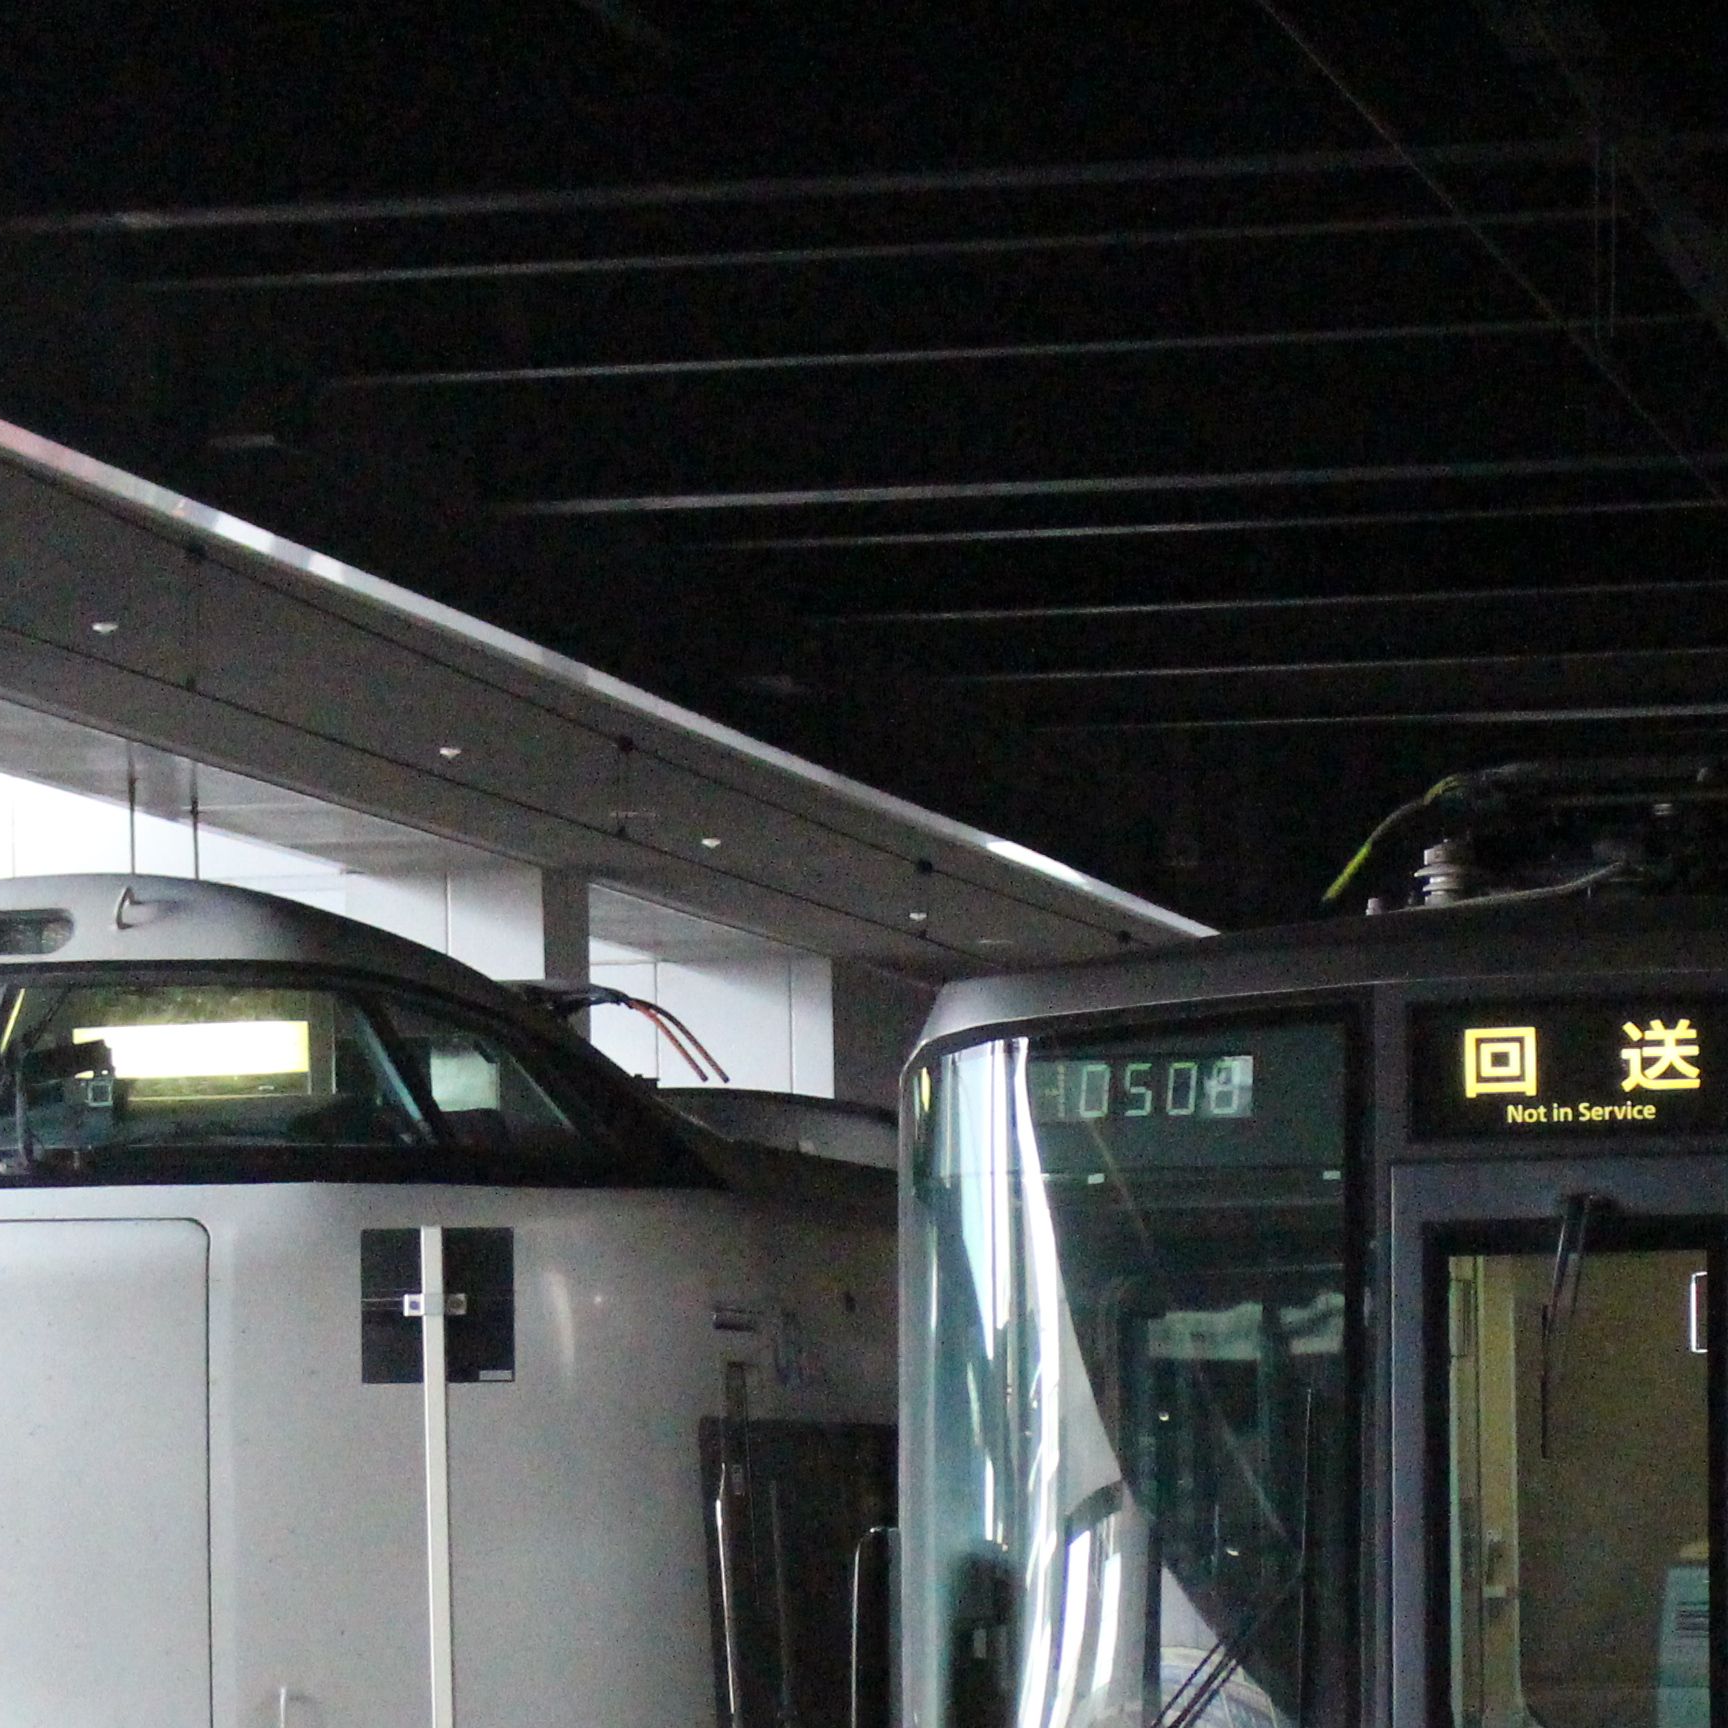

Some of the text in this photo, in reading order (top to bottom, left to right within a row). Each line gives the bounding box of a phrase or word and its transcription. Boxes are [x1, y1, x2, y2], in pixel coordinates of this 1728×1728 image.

[1506, 1101, 1657, 1124] Not in Service
